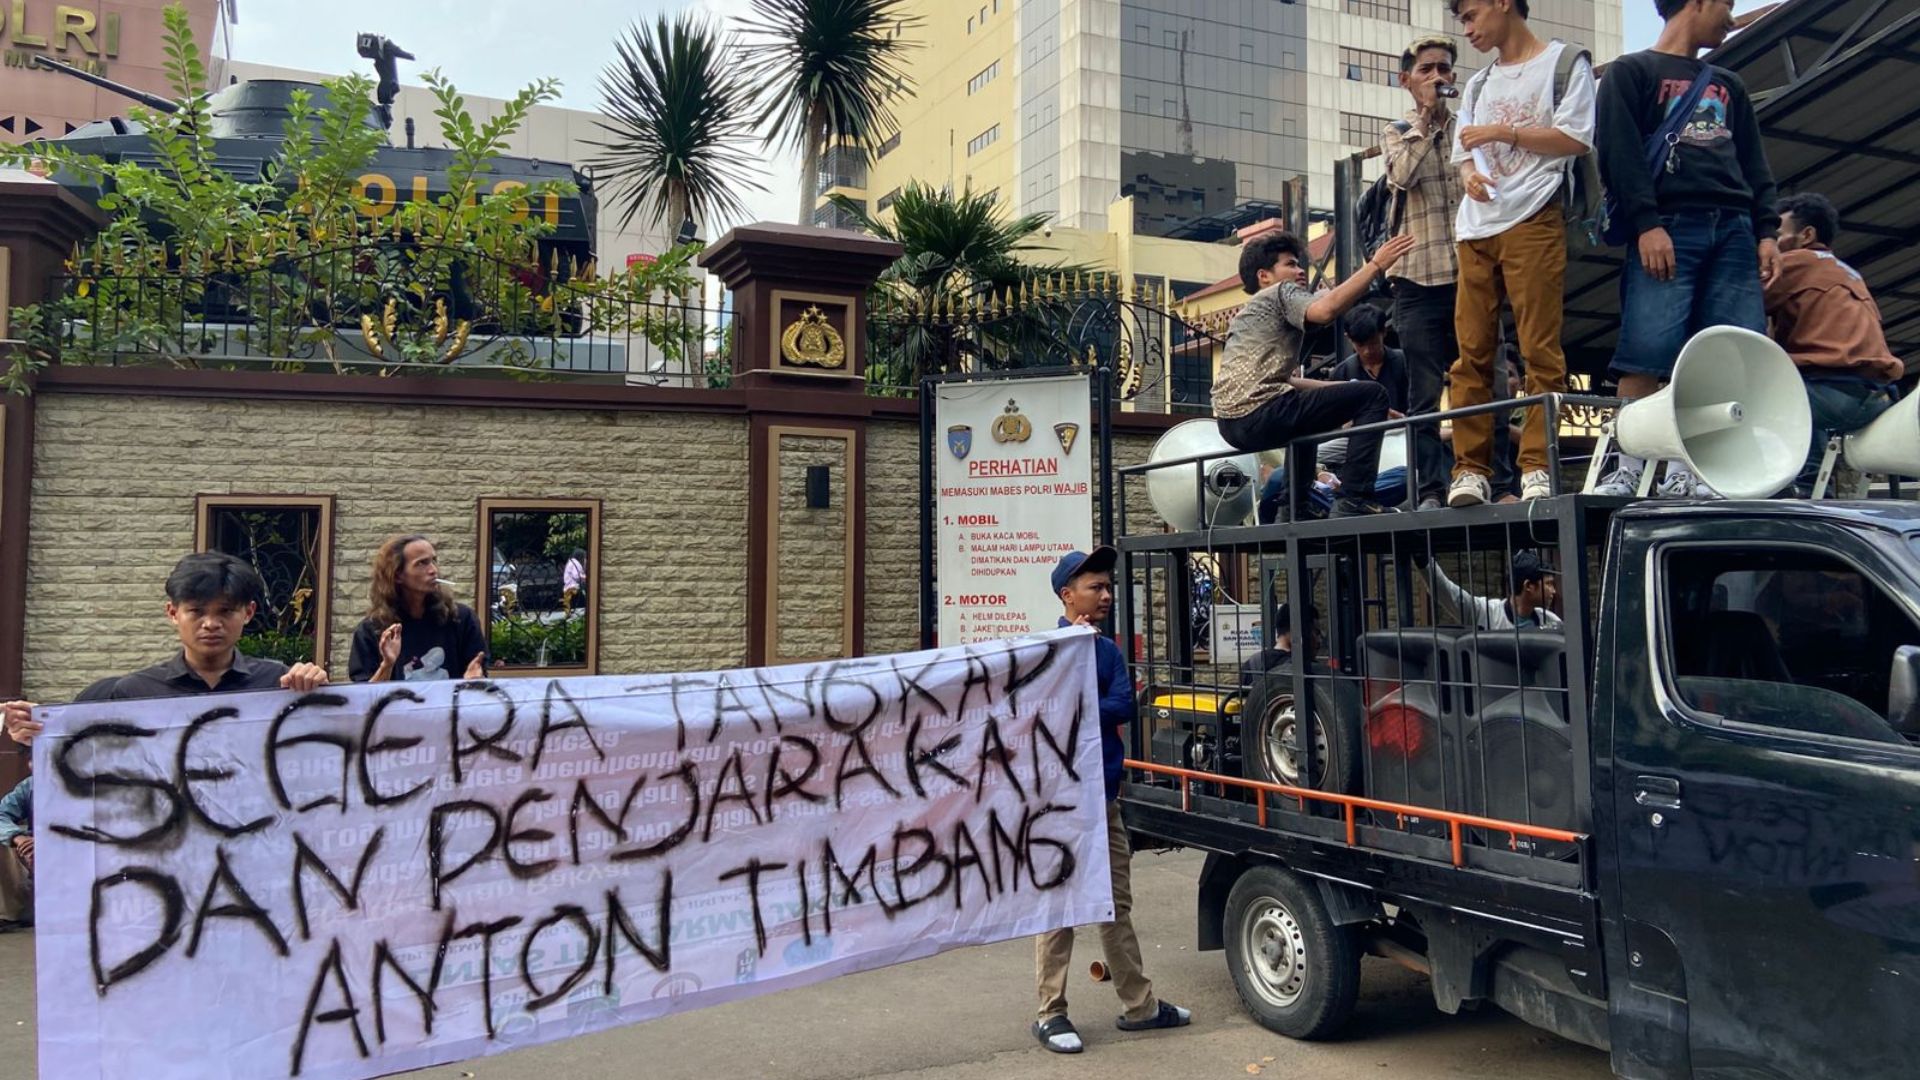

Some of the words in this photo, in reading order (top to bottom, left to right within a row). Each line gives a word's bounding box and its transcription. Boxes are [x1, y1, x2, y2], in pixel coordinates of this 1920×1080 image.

[0, 0, 120, 58] LRI
[969, 458, 1058, 477] PERHATIAN
[942, 487, 988, 497] MEMASUKI
[990, 486, 1021, 496] MABES
[1024, 484, 1051, 495] POLRI
[1053, 482, 1088, 495] WAJIB
[943, 516, 954, 525] 1.
[958, 515, 999, 526] MOBIL
[970, 532, 992, 541] BUKA
[993, 532, 1015, 540] KACA
[1016, 531, 1039, 540] MOBIL
[971, 544, 998, 552] MALAM
[999, 544, 1018, 552] HARI
[1019, 543, 1045, 552] LAMPU
[1047, 543, 1075, 551] UTAMA
[971, 556, 1012, 565] DIMATIKAN
[1013, 555, 1030, 564] DAN
[1031, 555, 1058, 564] LAMPU
[971, 567, 1017, 577] DIHIDUPKAN
[944, 595, 956, 605] 2.
[959, 594, 1007, 605] MOTOR
[972, 612, 993, 621] HELM
[994, 612, 1027, 621] DILEPAS
[997, 624, 1031, 633] DILEPAS
[49, 679, 604, 850] SEGERA
[625, 642, 1056, 750] TANGKAP
[90, 826, 386, 997] DAN
[429, 690, 1086, 911] PENJARAKAN
[290, 868, 673, 1077] ANTON
[719, 803, 1076, 958] TIMBANG
